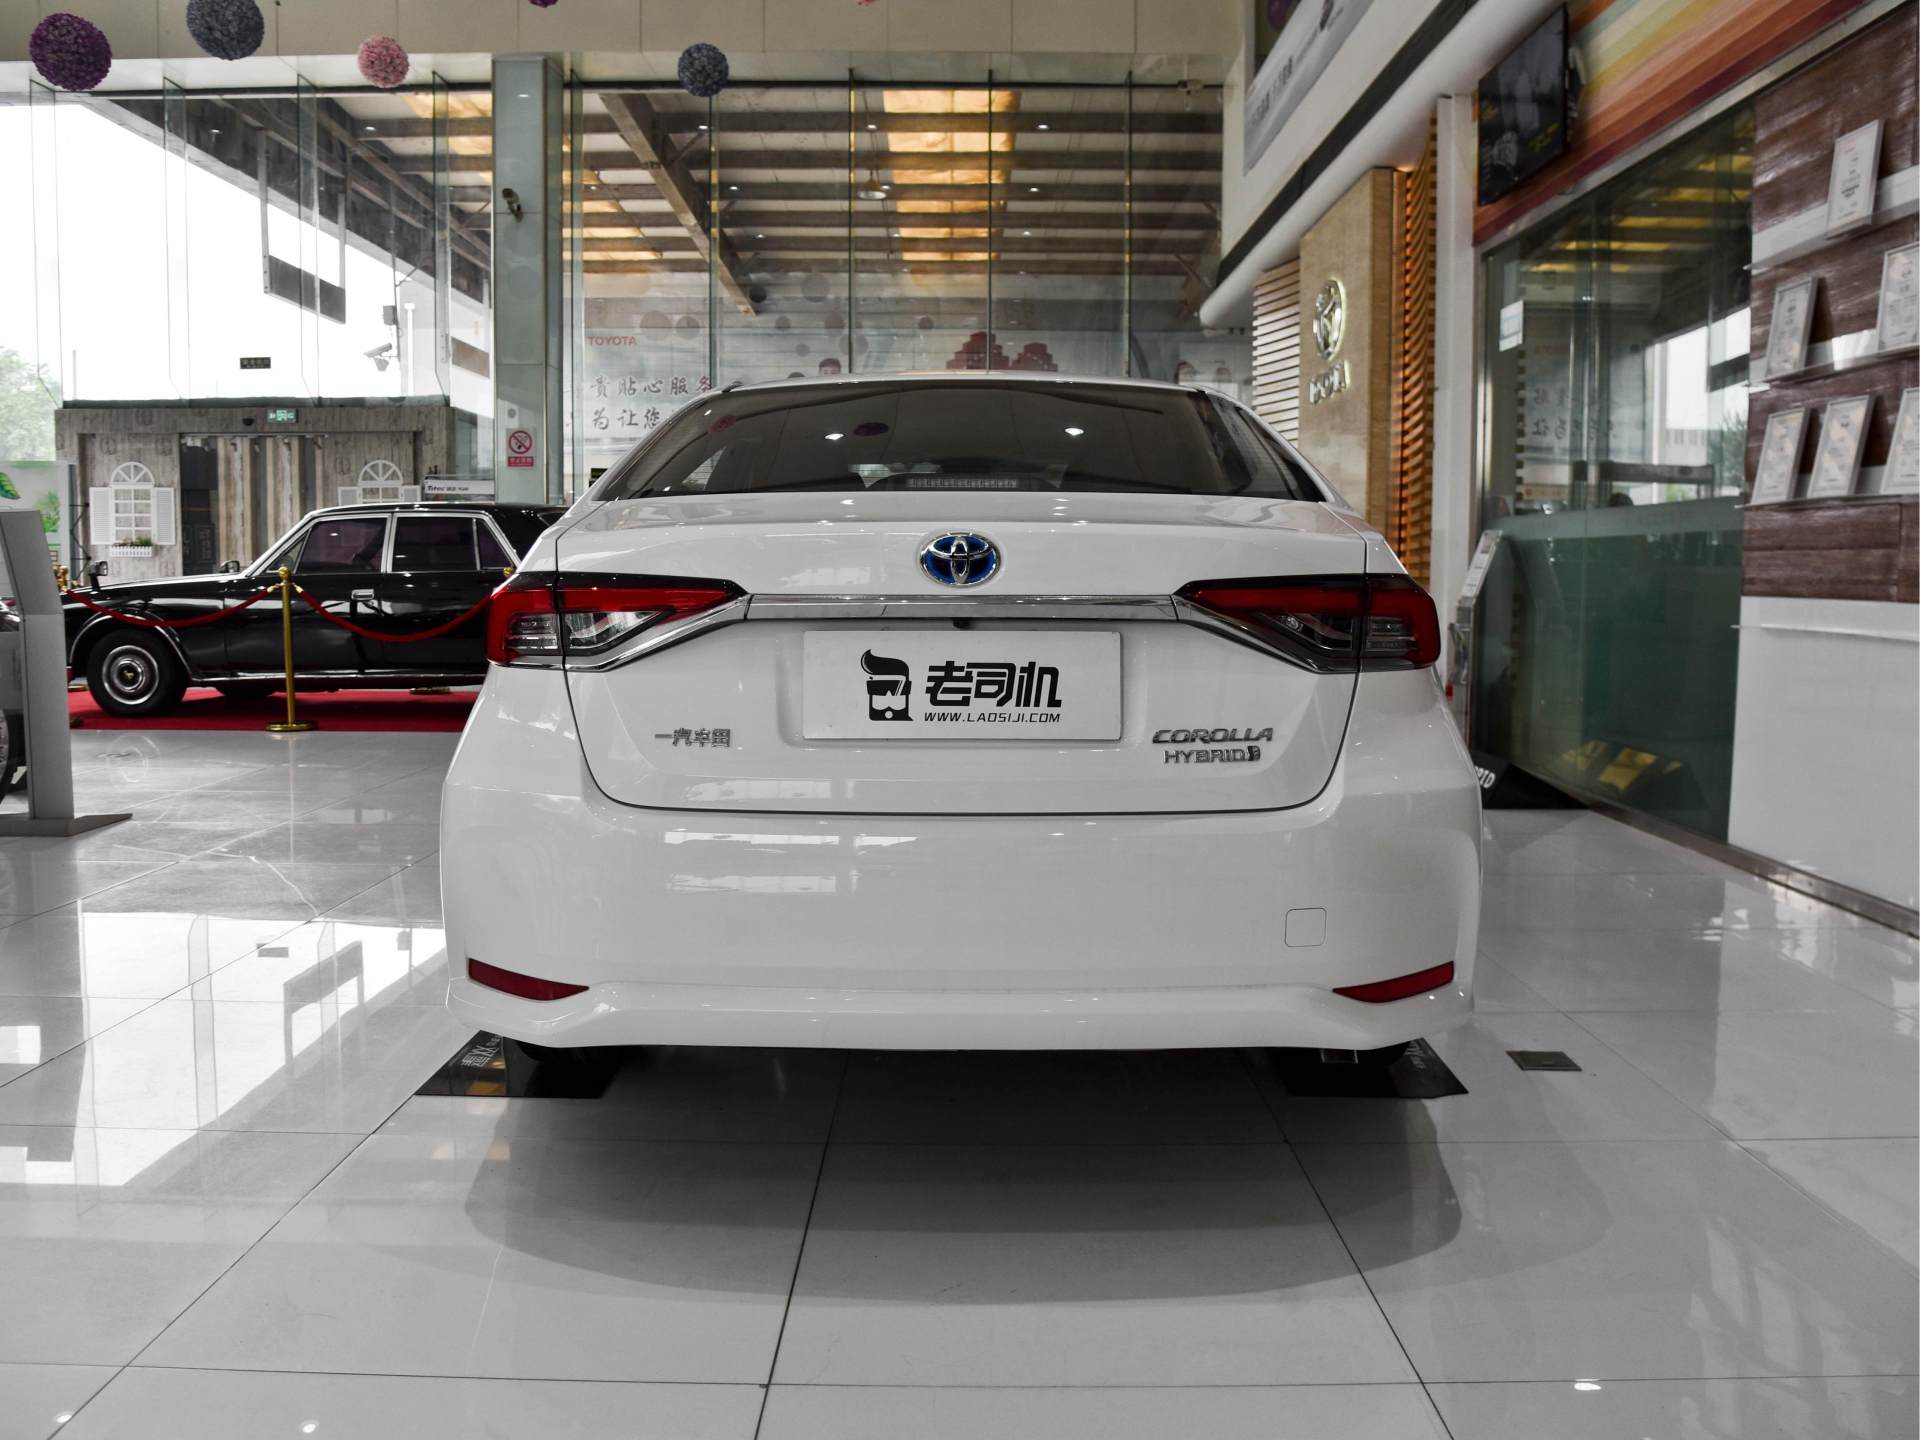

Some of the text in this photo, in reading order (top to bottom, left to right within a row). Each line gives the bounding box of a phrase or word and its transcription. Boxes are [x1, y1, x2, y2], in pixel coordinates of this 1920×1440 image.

[589, 336, 638, 346] TOYOTA
[924, 660, 1062, 708] 老司机
[924, 712, 1061, 723] WWW.LAOSIJI.COM
[1152, 727, 1274, 745] COROLLA
[1163, 749, 1249, 764] HYBRID
